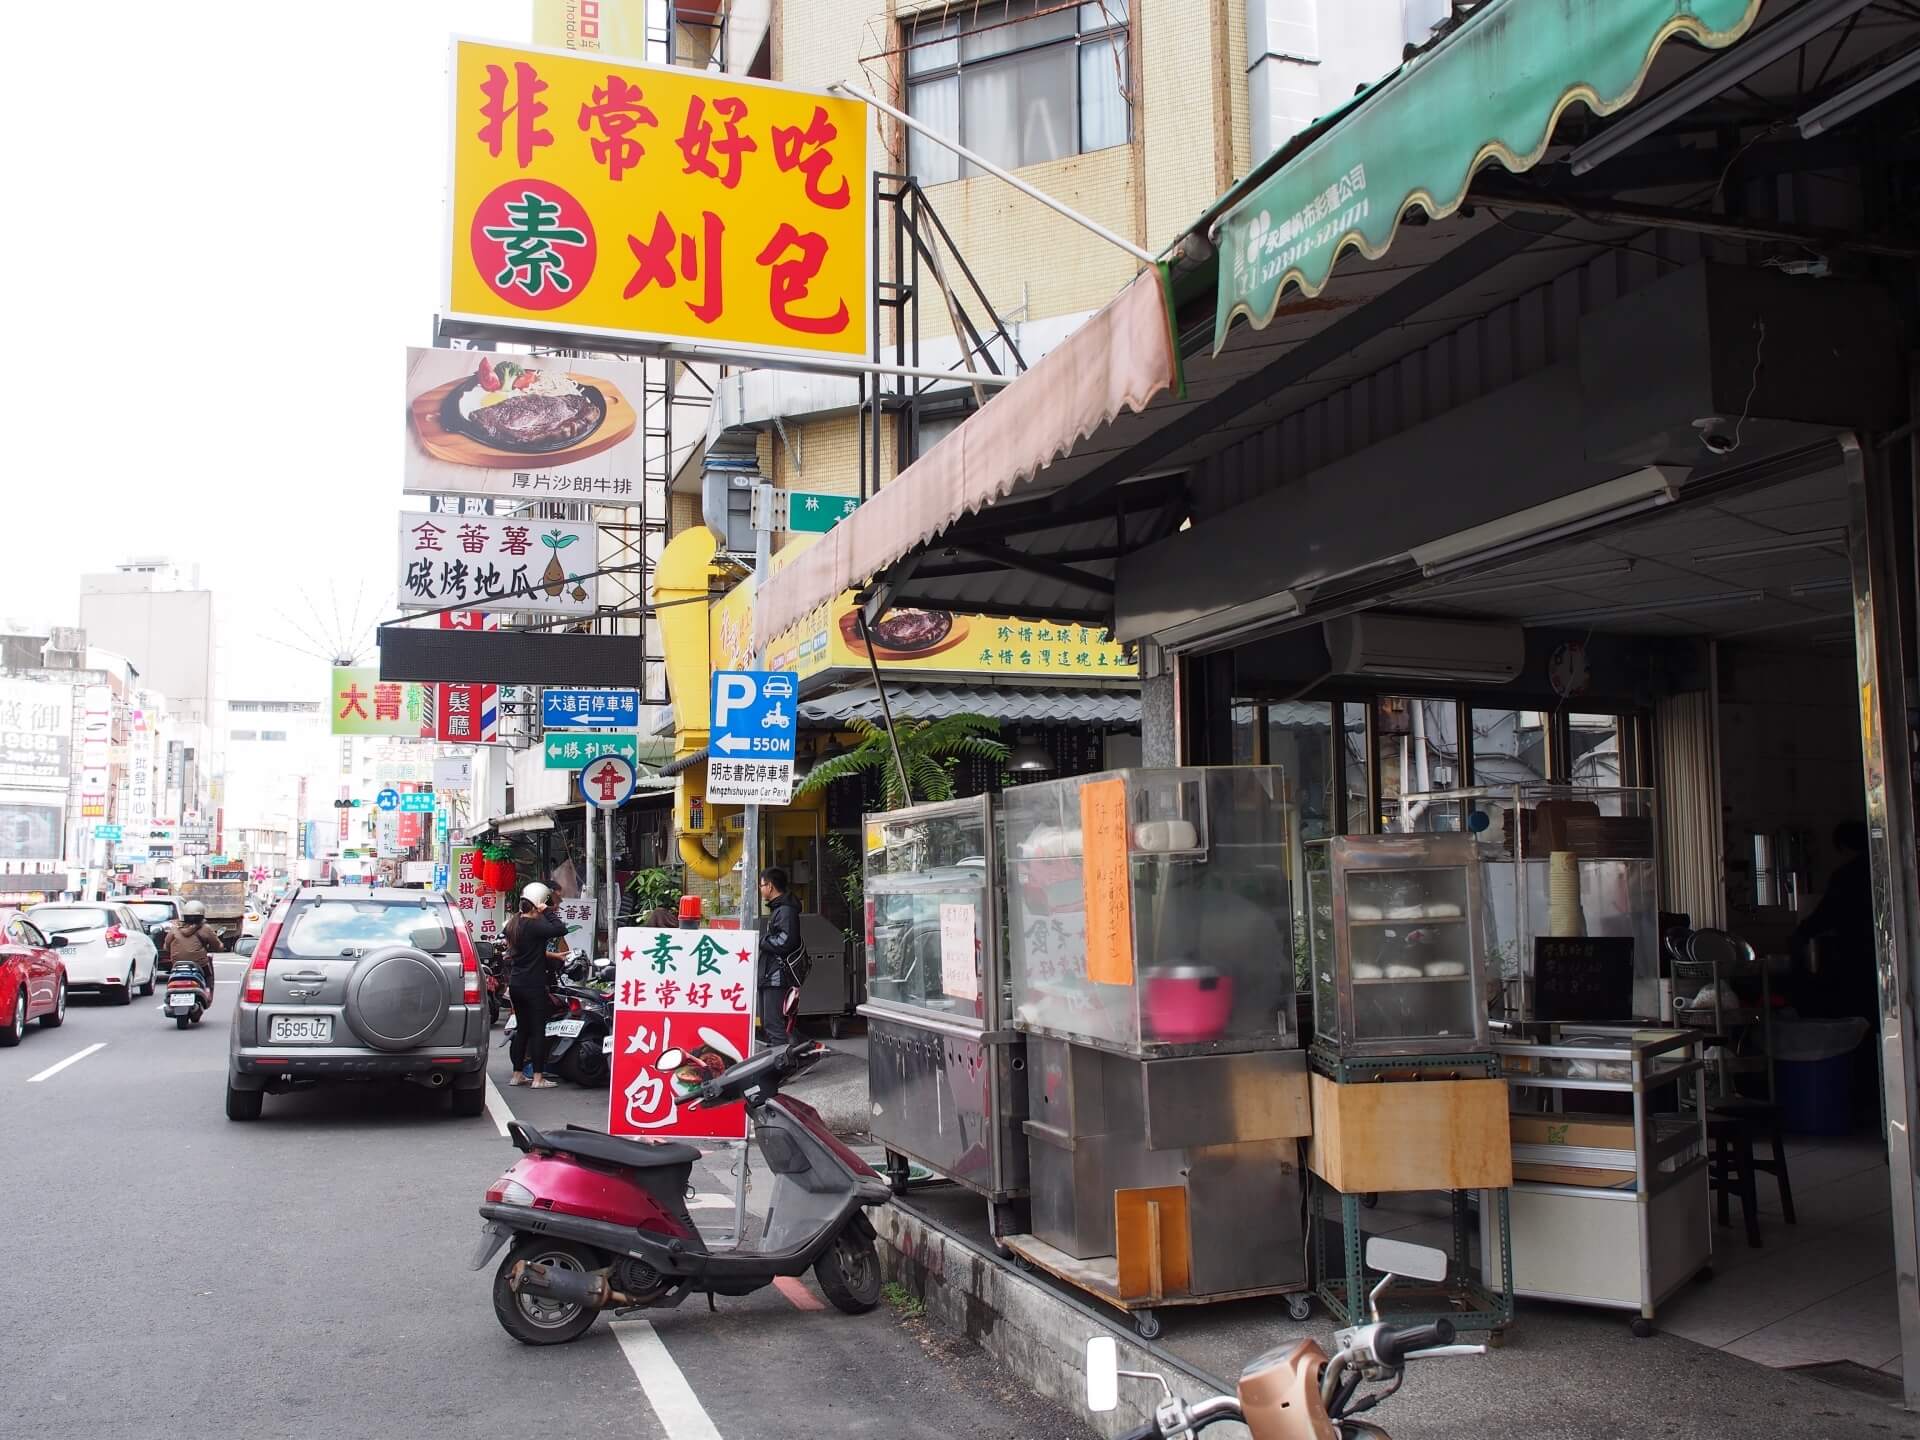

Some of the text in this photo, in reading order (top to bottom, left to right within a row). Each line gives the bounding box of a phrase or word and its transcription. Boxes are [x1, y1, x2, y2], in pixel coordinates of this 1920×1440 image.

[477, 62, 850, 209] 非常好吃
[483, 192, 850, 334] 素 刈包
[511, 472, 632, 495] 厚片沙朗牛排
[411, 520, 533, 556] 金蕃薯
[405, 556, 538, 601] 碳烤地瓜
[979, 647, 1130, 666] 疼惜台灣這塊土地
[448, 683, 470, 737] 髮廳
[548, 694, 634, 713] 大遠百停車場
[716, 674, 757, 728] P
[563, 742, 619, 759] 勝利路
[753, 737, 790, 752] 550M
[711, 762, 790, 783] 明志書院停車場
[709, 785, 787, 798] Mingzhishuyuan Car Park
[460, 853, 474, 910] 成品批發
[642, 933, 729, 976] 素食
[619, 979, 748, 1011] 非常好吃
[624, 1016, 678, 1129] 刈包
